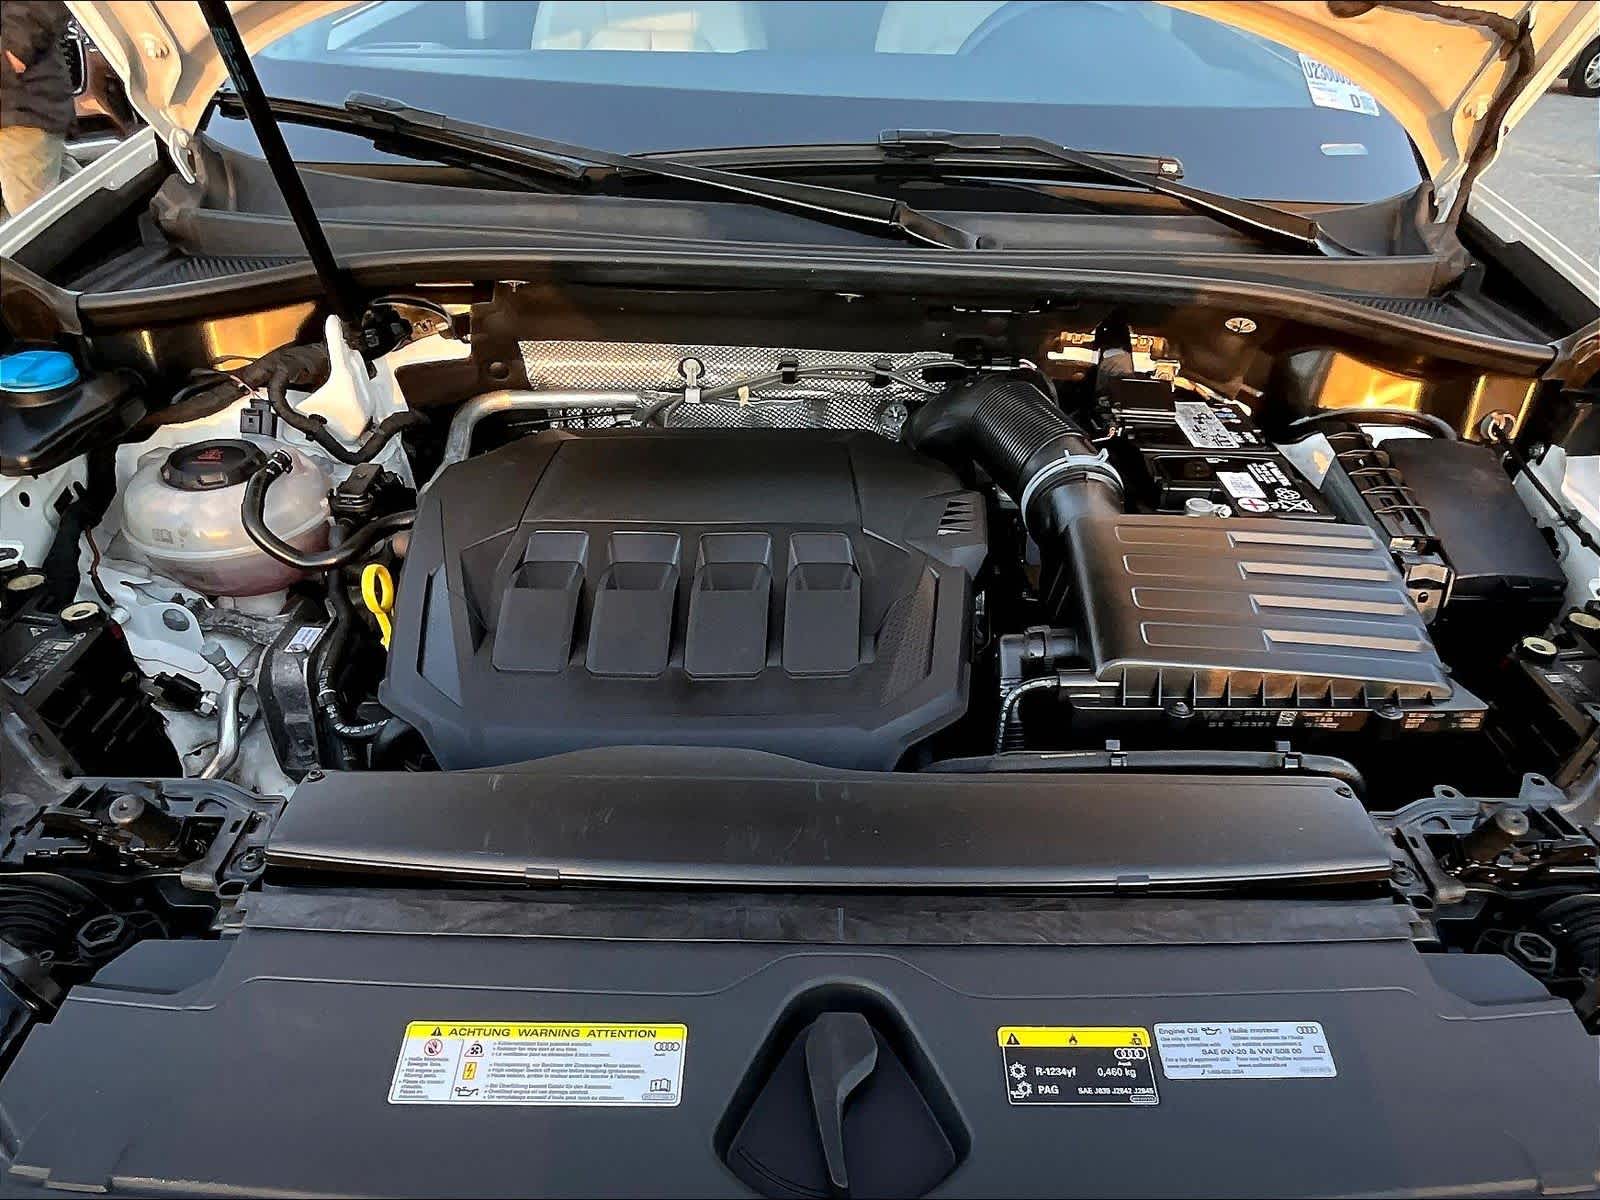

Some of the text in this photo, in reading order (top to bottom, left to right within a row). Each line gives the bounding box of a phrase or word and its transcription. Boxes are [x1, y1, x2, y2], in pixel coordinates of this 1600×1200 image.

[1349, 94, 1361, 108] D
[447, 1027, 657, 1038] ACHTUNG WARNING ATTENTION
[1035, 1066, 1077, 1077] R-1234yf
[1124, 1067, 1137, 1078] kg
[1037, 1085, 1060, 1095] PAG
